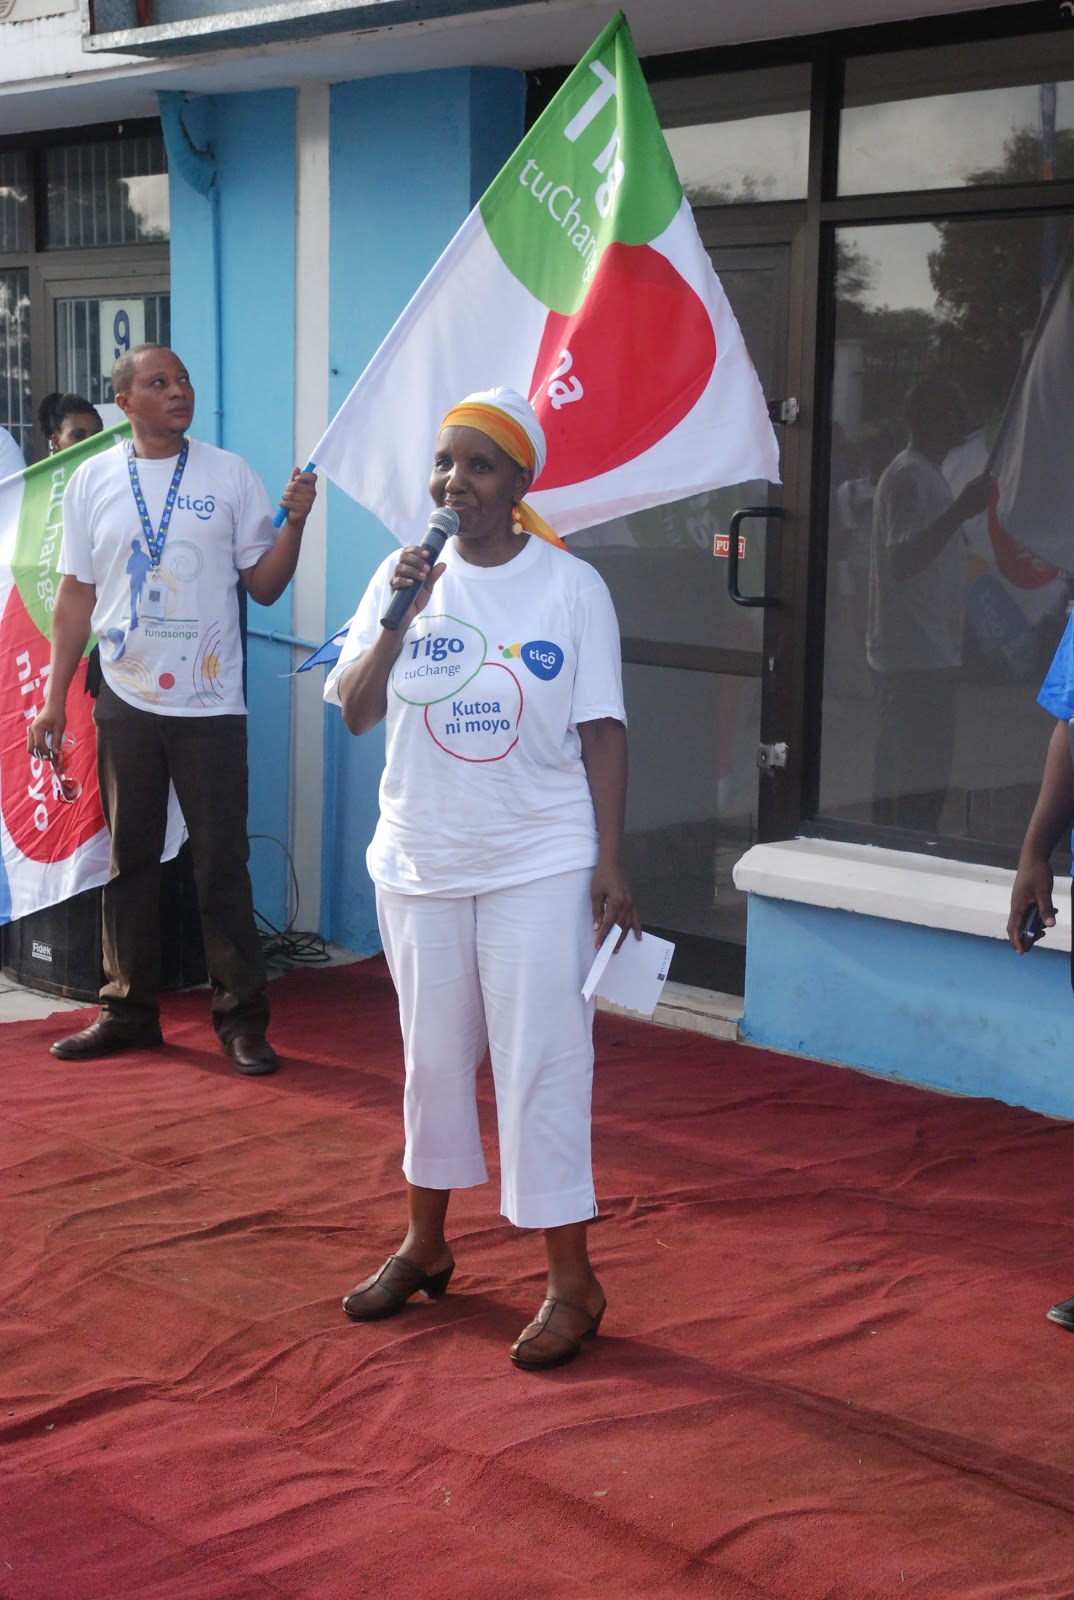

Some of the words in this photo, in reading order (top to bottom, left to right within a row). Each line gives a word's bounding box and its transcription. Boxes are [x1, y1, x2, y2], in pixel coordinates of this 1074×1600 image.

[176, 494, 215, 520] tigo
[715, 540, 744, 553] PUH
[144, 628, 198, 640] tunasonga
[409, 632, 465, 662] Tigo
[529, 650, 557, 669] tigo
[15, 650, 41, 696] ni
[404, 663, 462, 680] tuChange
[452, 700, 501, 717] Kutoa
[445, 718, 461, 735] ni
[465, 717, 511, 735] moyo
